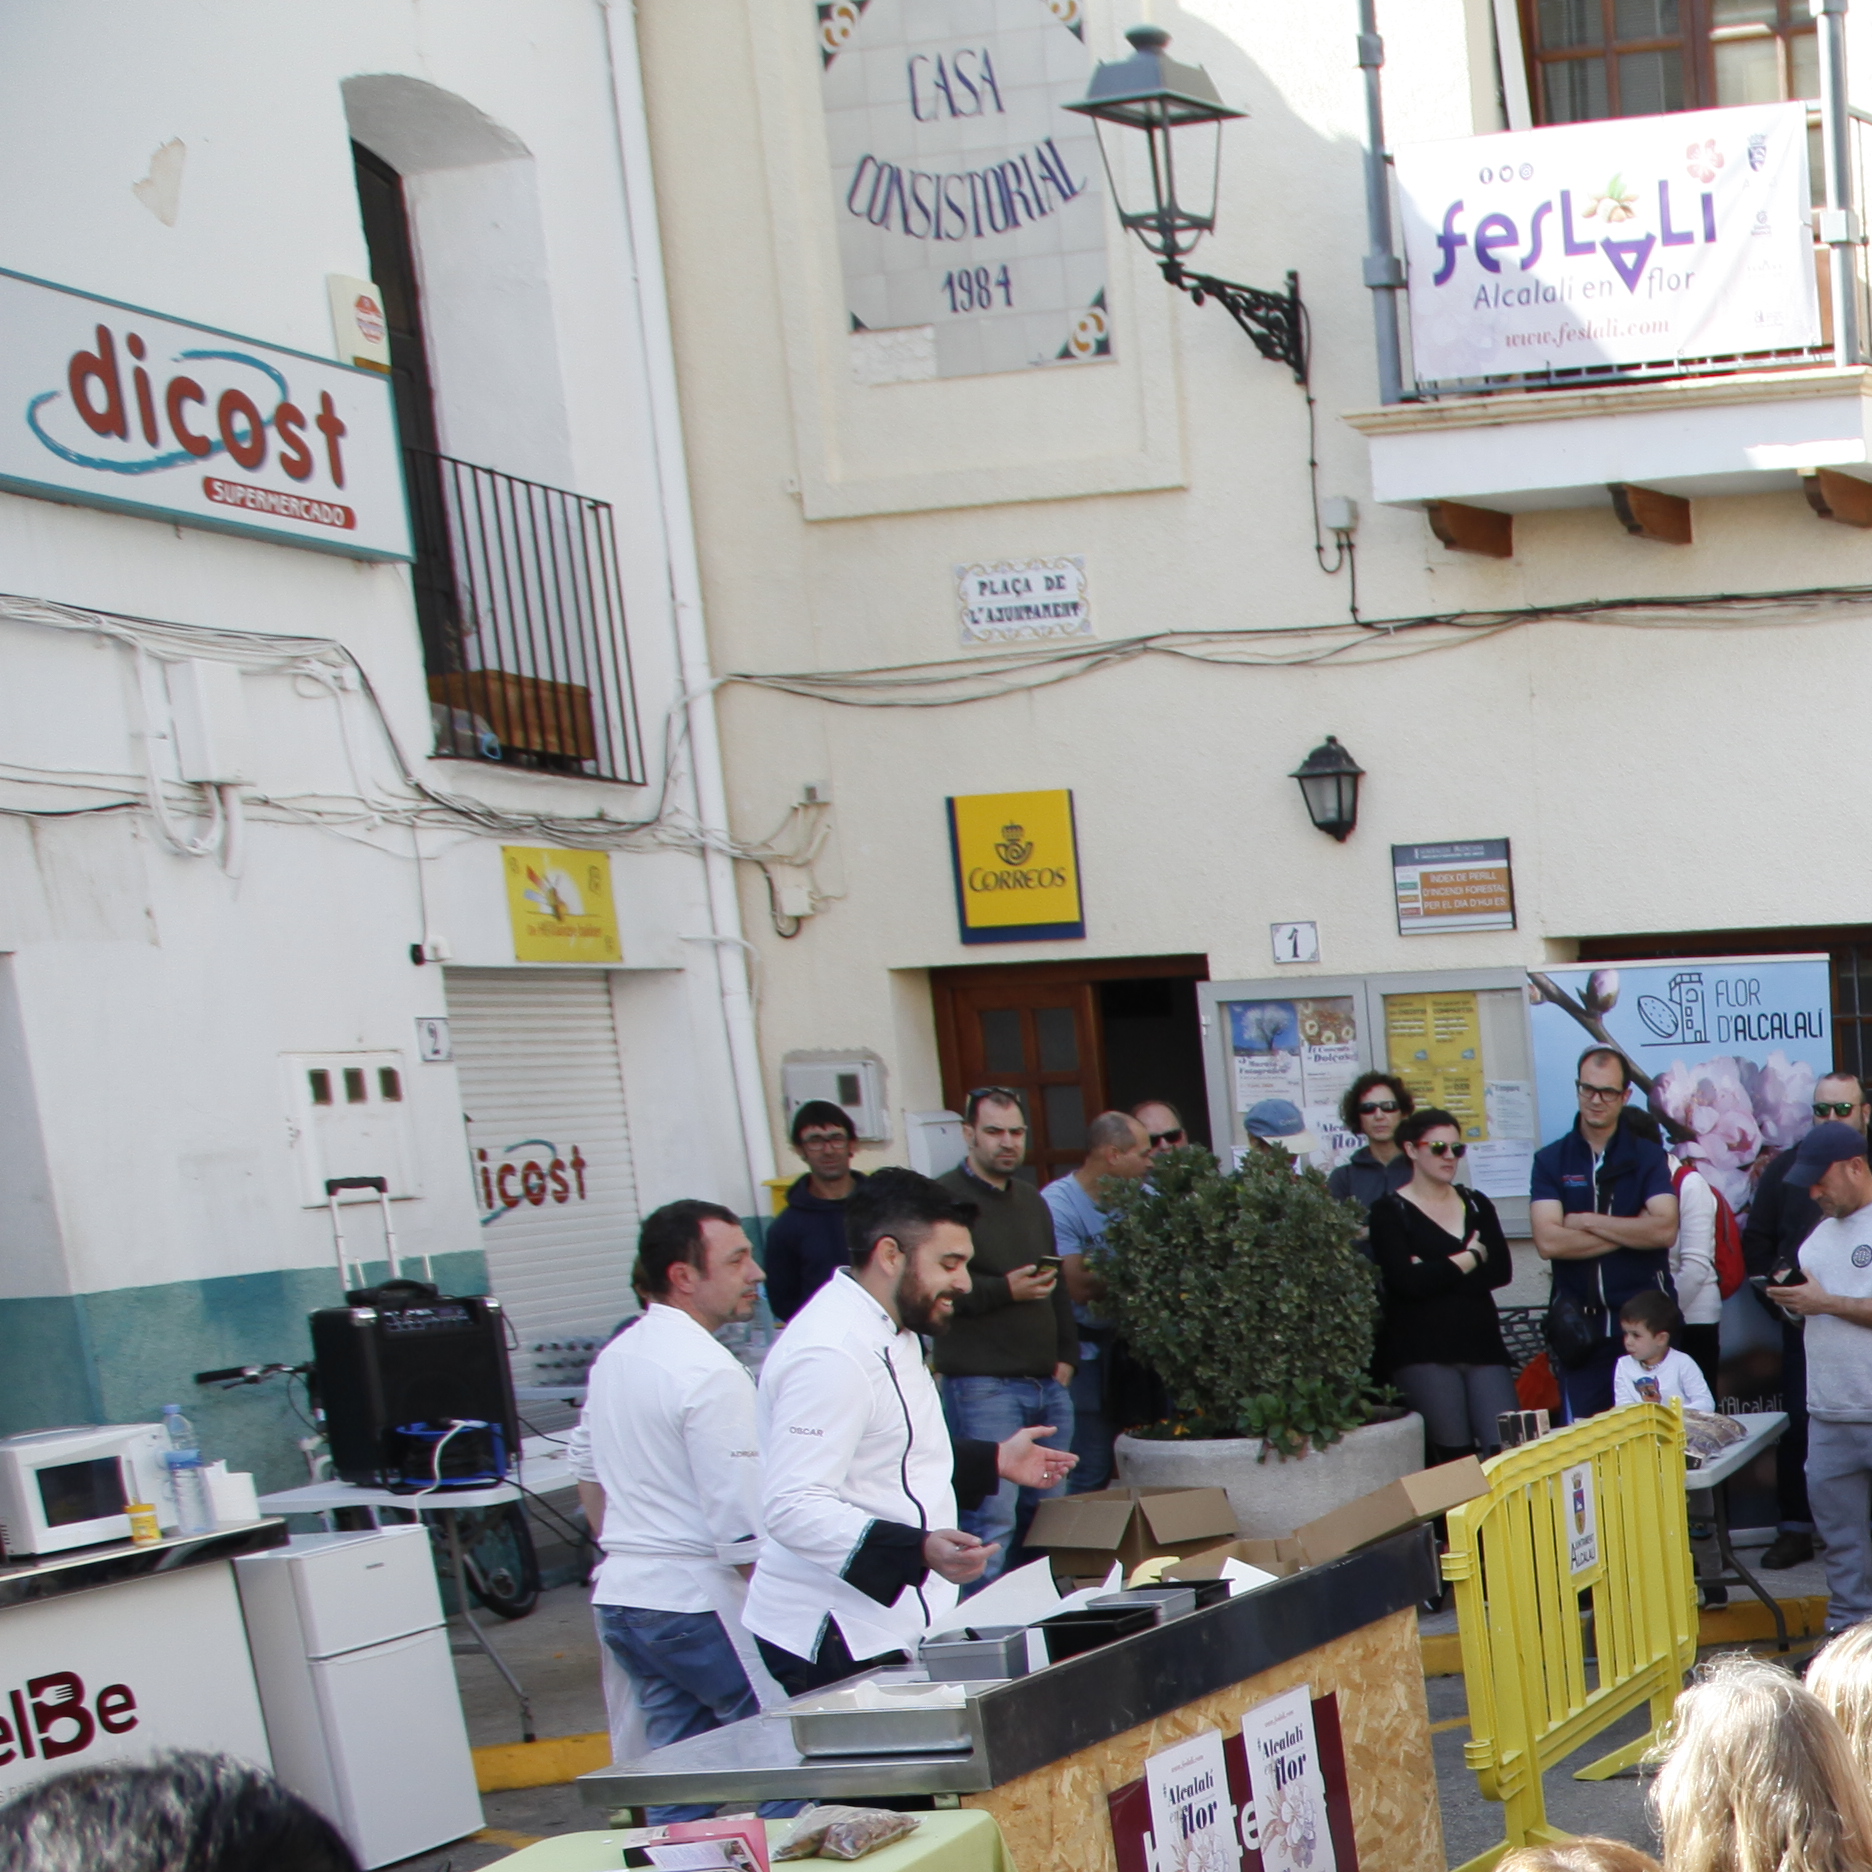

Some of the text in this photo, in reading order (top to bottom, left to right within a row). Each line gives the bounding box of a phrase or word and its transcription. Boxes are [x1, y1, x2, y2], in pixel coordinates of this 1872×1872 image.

[907, 47, 1004, 122] CASA
[847, 137, 1087, 241] CONSISTORIAL
[942, 264, 1013, 313] 1984
[1582, 281, 1612, 299] en
[1648, 267, 1696, 299] flor
[1505, 317, 1670, 348] www.feslali.com
[69, 323, 346, 490] dicost
[212, 481, 346, 527] SUPERMERCADO
[977, 574, 1067, 597] PLAÇA DE
[968, 867, 1067, 893] CORREOS
[1287, 927, 1300, 958] 1
[1715, 978, 1761, 1007] FLOR
[427, 1021, 441, 1055] 2
[1717, 1008, 1823, 1043] D'ALCALALÍ
[1332, 1133, 1366, 1150] flor
[476, 1144, 587, 1210] icost
[789, 1426, 824, 1437] OSCAR
[1168, 1768, 1214, 1807] Alcalalí
[1275, 1752, 1307, 1791] flor
[1181, 1800, 1218, 1840] flor
